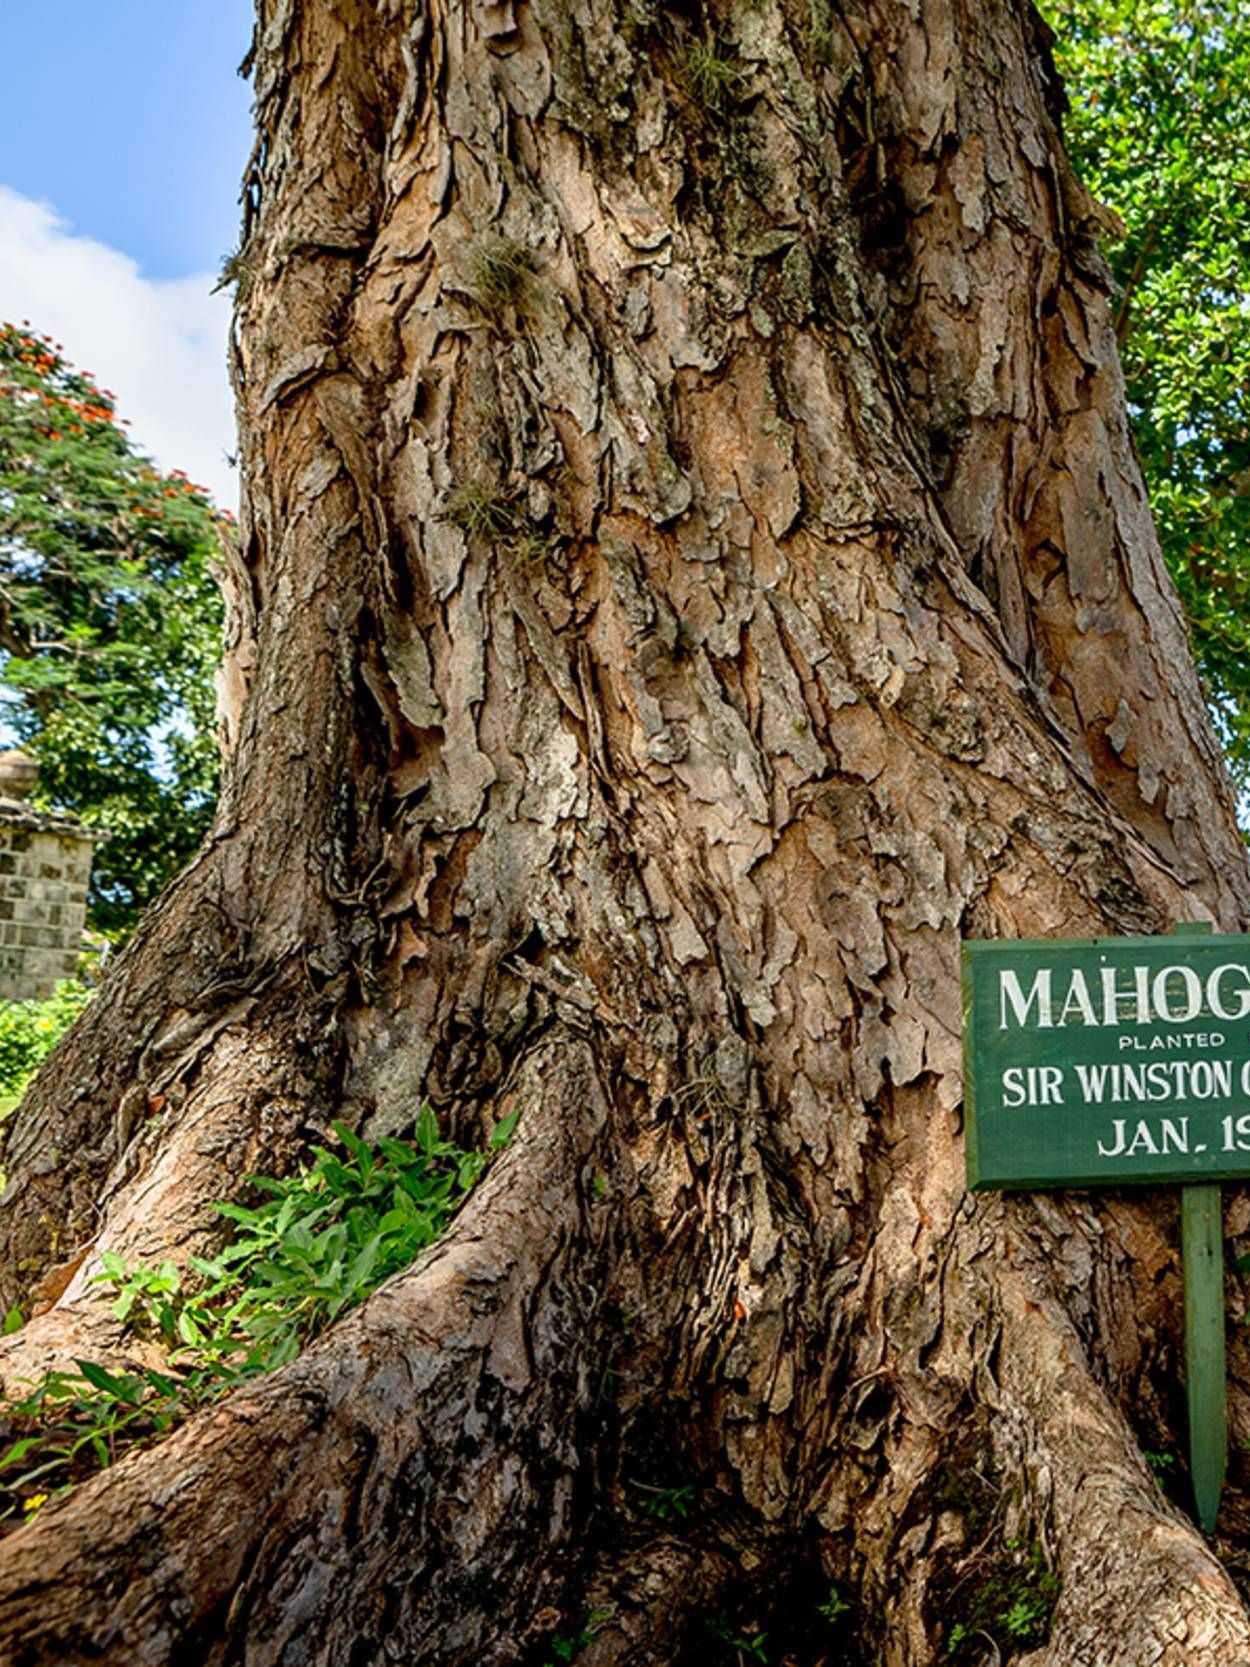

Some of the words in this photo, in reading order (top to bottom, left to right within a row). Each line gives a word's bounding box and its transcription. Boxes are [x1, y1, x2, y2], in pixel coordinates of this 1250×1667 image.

[1118, 1032, 1225, 1050] PLANTED
[1002, 1066, 1065, 1107] SIR
[1074, 1060, 1233, 1103] WINSTON
[1097, 1116, 1208, 1157] JAN.
